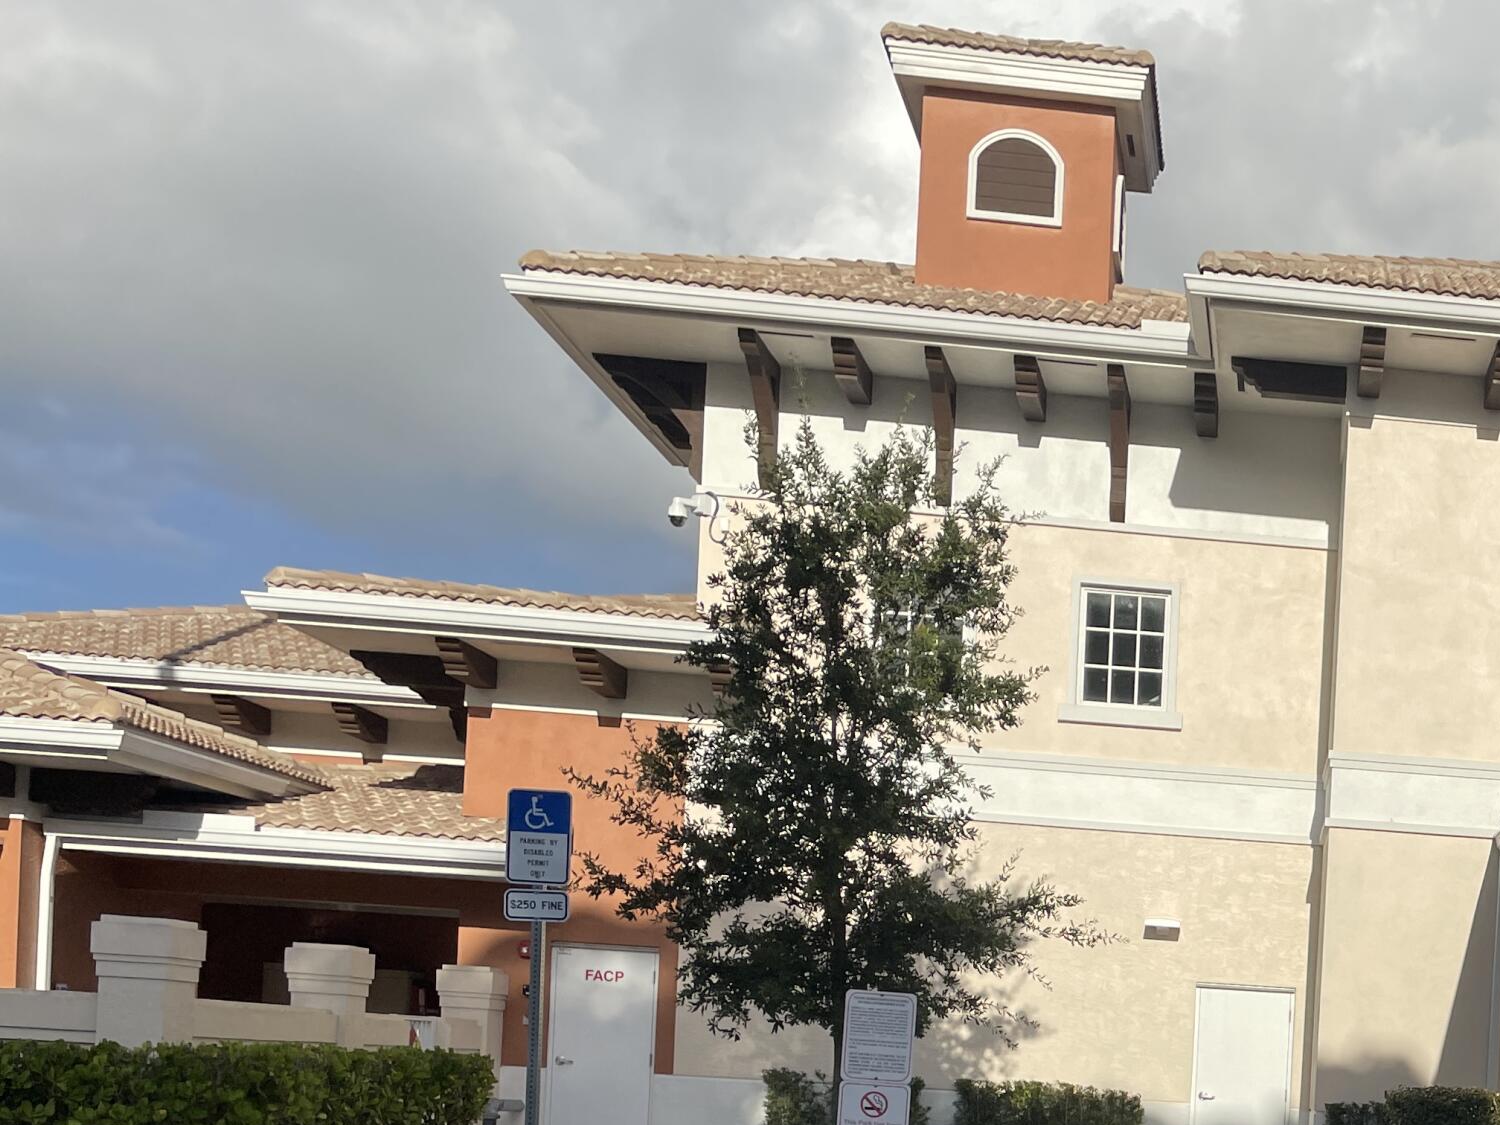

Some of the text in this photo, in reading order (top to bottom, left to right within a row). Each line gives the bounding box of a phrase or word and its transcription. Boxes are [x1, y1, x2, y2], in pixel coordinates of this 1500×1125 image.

[519, 838, 546, 846] PARKING
[523, 848, 554, 857] DISABLED
[527, 859, 549, 867] PERMIT
[510, 899, 564, 911] $250 FINE
[585, 969, 625, 983] FACP
